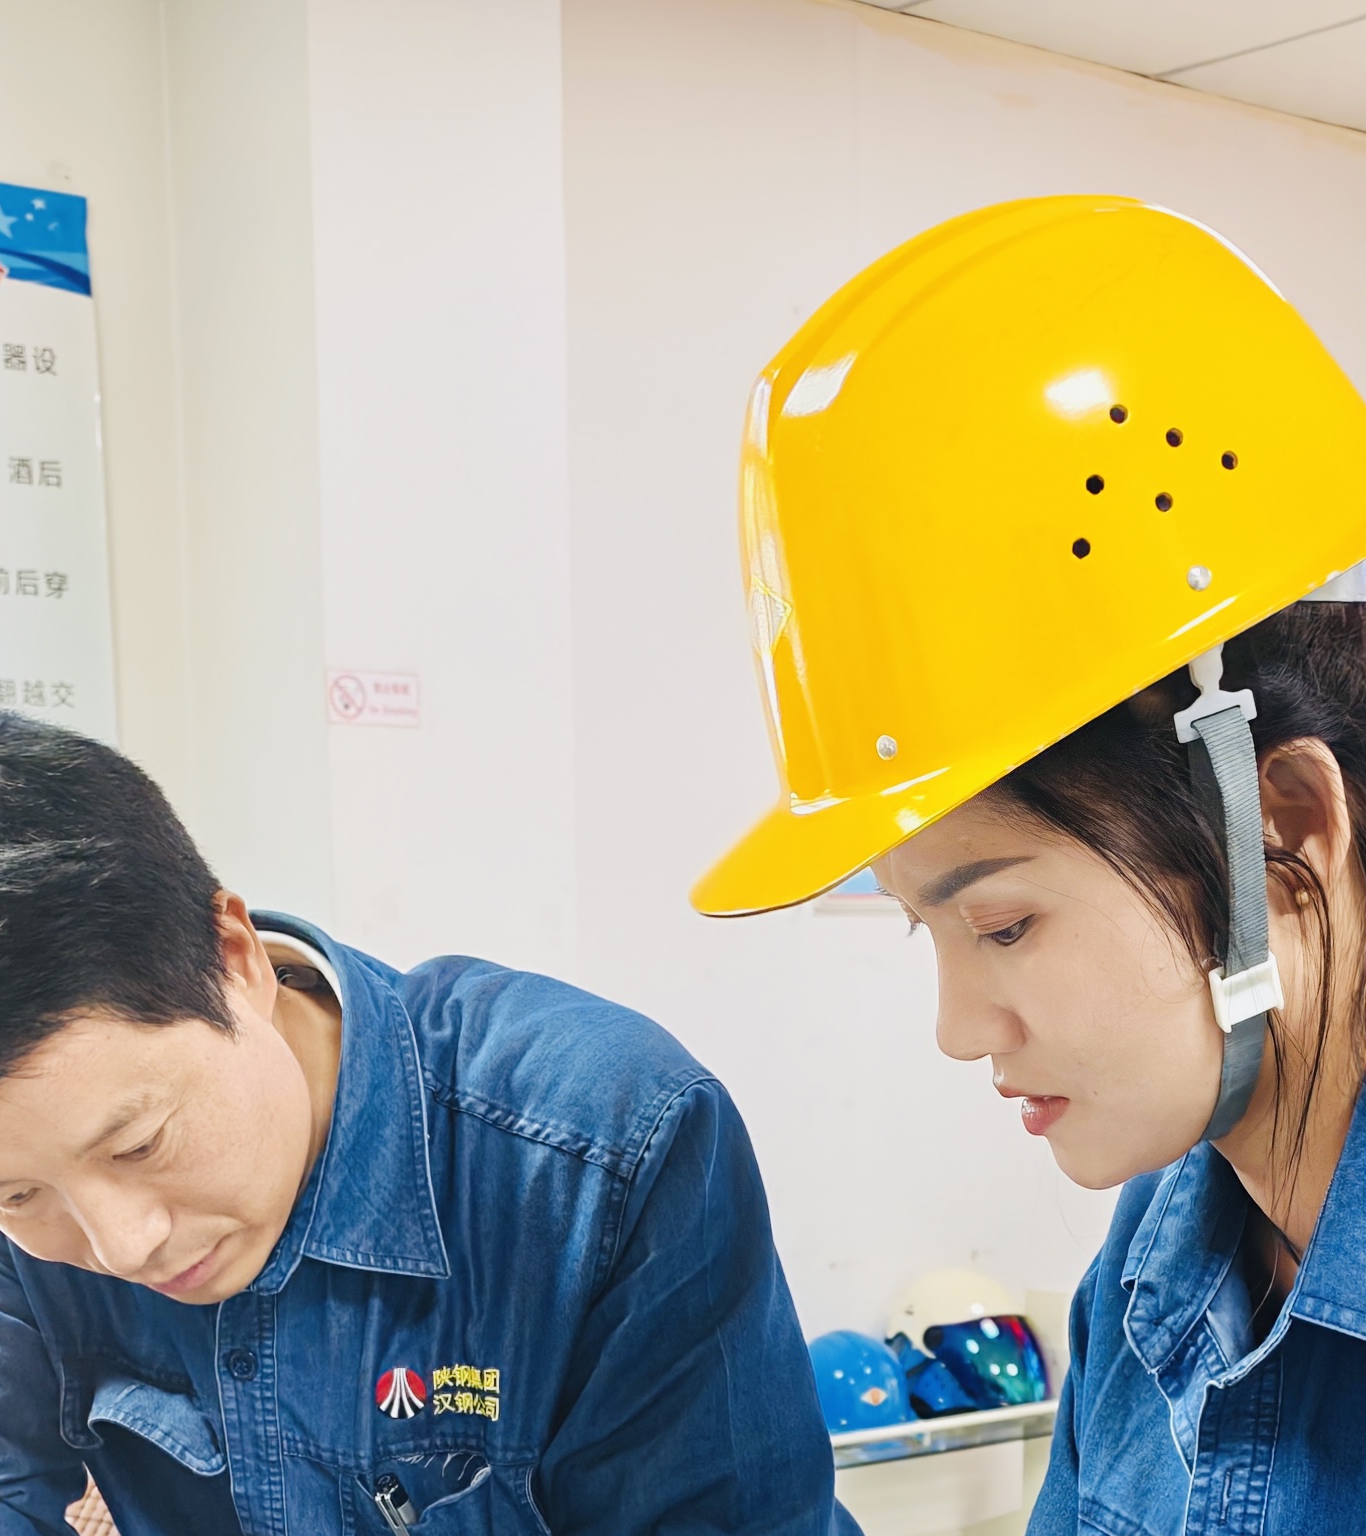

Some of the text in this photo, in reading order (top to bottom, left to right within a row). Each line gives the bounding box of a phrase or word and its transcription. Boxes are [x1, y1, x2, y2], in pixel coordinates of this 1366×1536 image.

[432, 1363, 501, 1394] 陕钢集团
[432, 1391, 500, 1421] 汉钢公司
